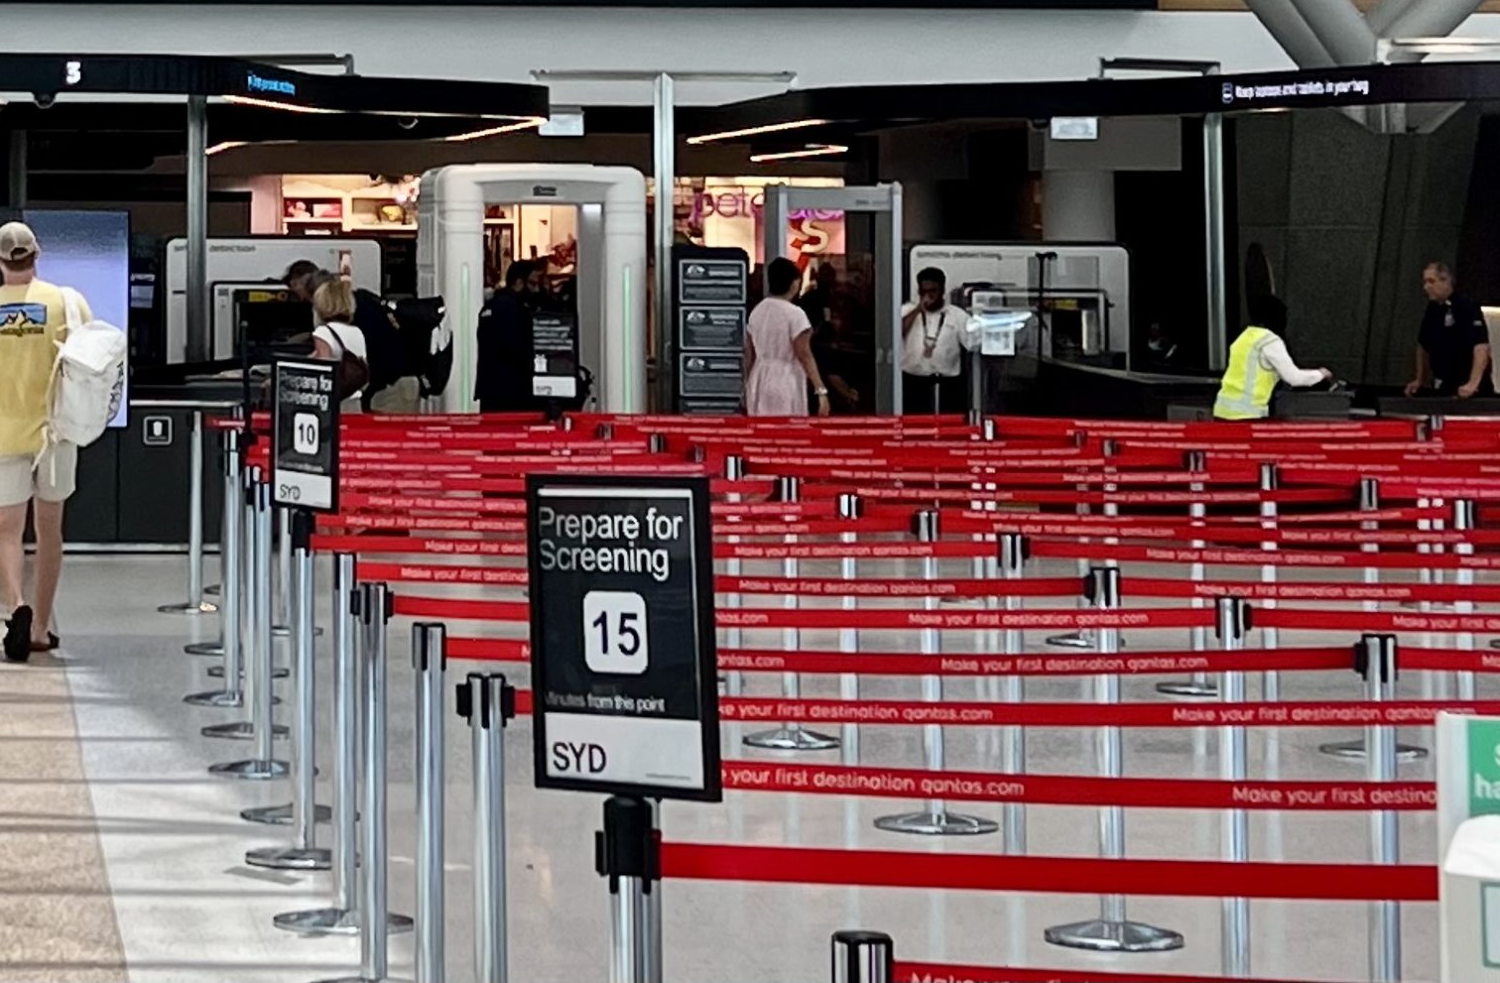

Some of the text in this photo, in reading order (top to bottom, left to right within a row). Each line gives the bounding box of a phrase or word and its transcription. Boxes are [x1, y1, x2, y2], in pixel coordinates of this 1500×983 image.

[66, 62, 81, 83] 3
[320, 374, 333, 392] for
[298, 423, 316, 446] 10
[280, 484, 301, 501] SYD
[539, 507, 683, 544] Prepare for
[540, 539, 669, 581] Screening
[739, 579, 770, 590] Make
[773, 581, 797, 592] your
[799, 581, 821, 592] first
[824, 582, 888, 593] destination
[1195, 584, 1225, 595] Make
[1228, 586, 1252, 597] your
[1255, 585, 1277, 596] first
[1279, 586, 1343, 597] destination
[908, 613, 943, 624] Make
[947, 615, 973, 626] your
[976, 614, 999, 624] first
[1002, 614, 1074, 625] destination
[592, 610, 641, 656] 15
[942, 658, 978, 671] Make
[982, 660, 1011, 673] your
[1016, 658, 1042, 671] first
[1046, 658, 1124, 670] destination
[587, 692, 613, 709] from
[613, 693, 634, 710] this
[636, 695, 665, 712] point
[739, 703, 993, 721] your first destination qantas.com
[1172, 706, 1381, 722] Make your first destination
[553, 741, 607, 774] SYD
[732, 769, 1024, 795] your first destination qantas.com
[1232, 786, 1437, 805] Make your first destina
